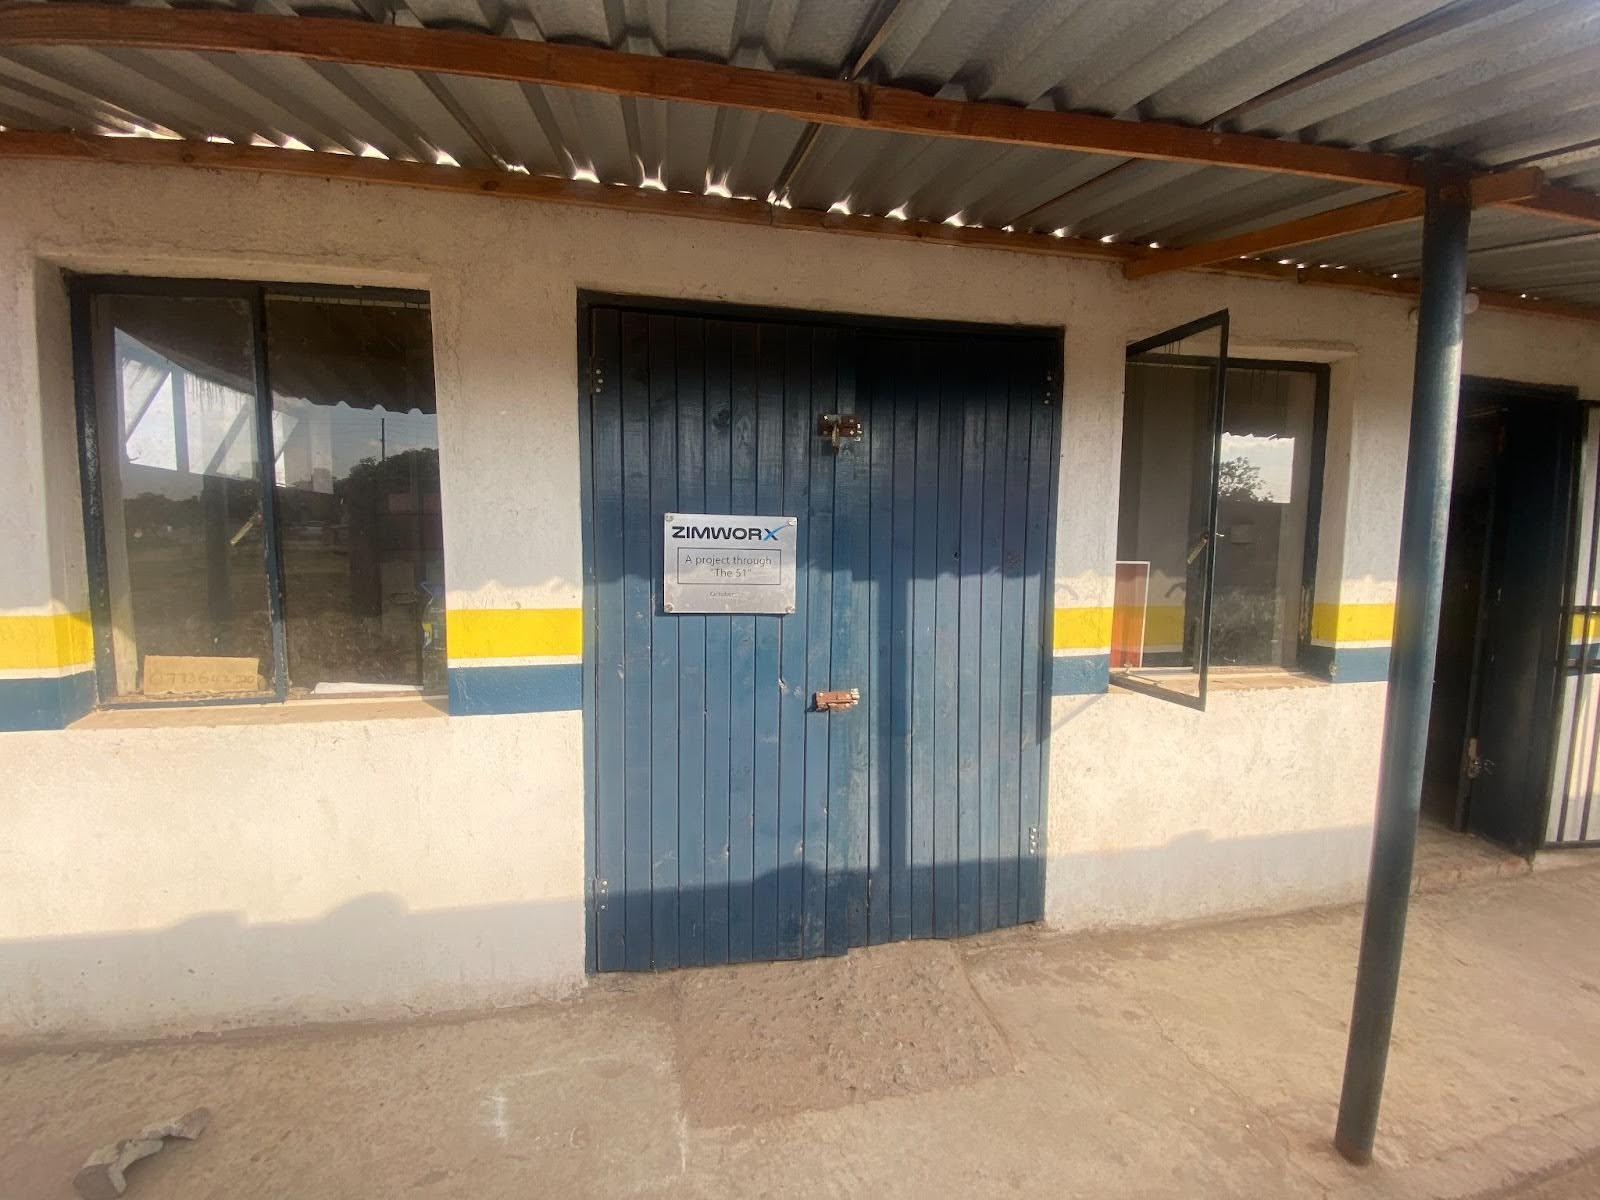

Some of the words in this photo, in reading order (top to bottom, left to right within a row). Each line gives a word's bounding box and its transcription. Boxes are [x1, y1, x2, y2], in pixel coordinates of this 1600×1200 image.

[671, 524, 782, 541] ZIMWORX
[684, 554, 693, 565] A
[695, 555, 730, 567] project
[732, 556, 772, 567] through
